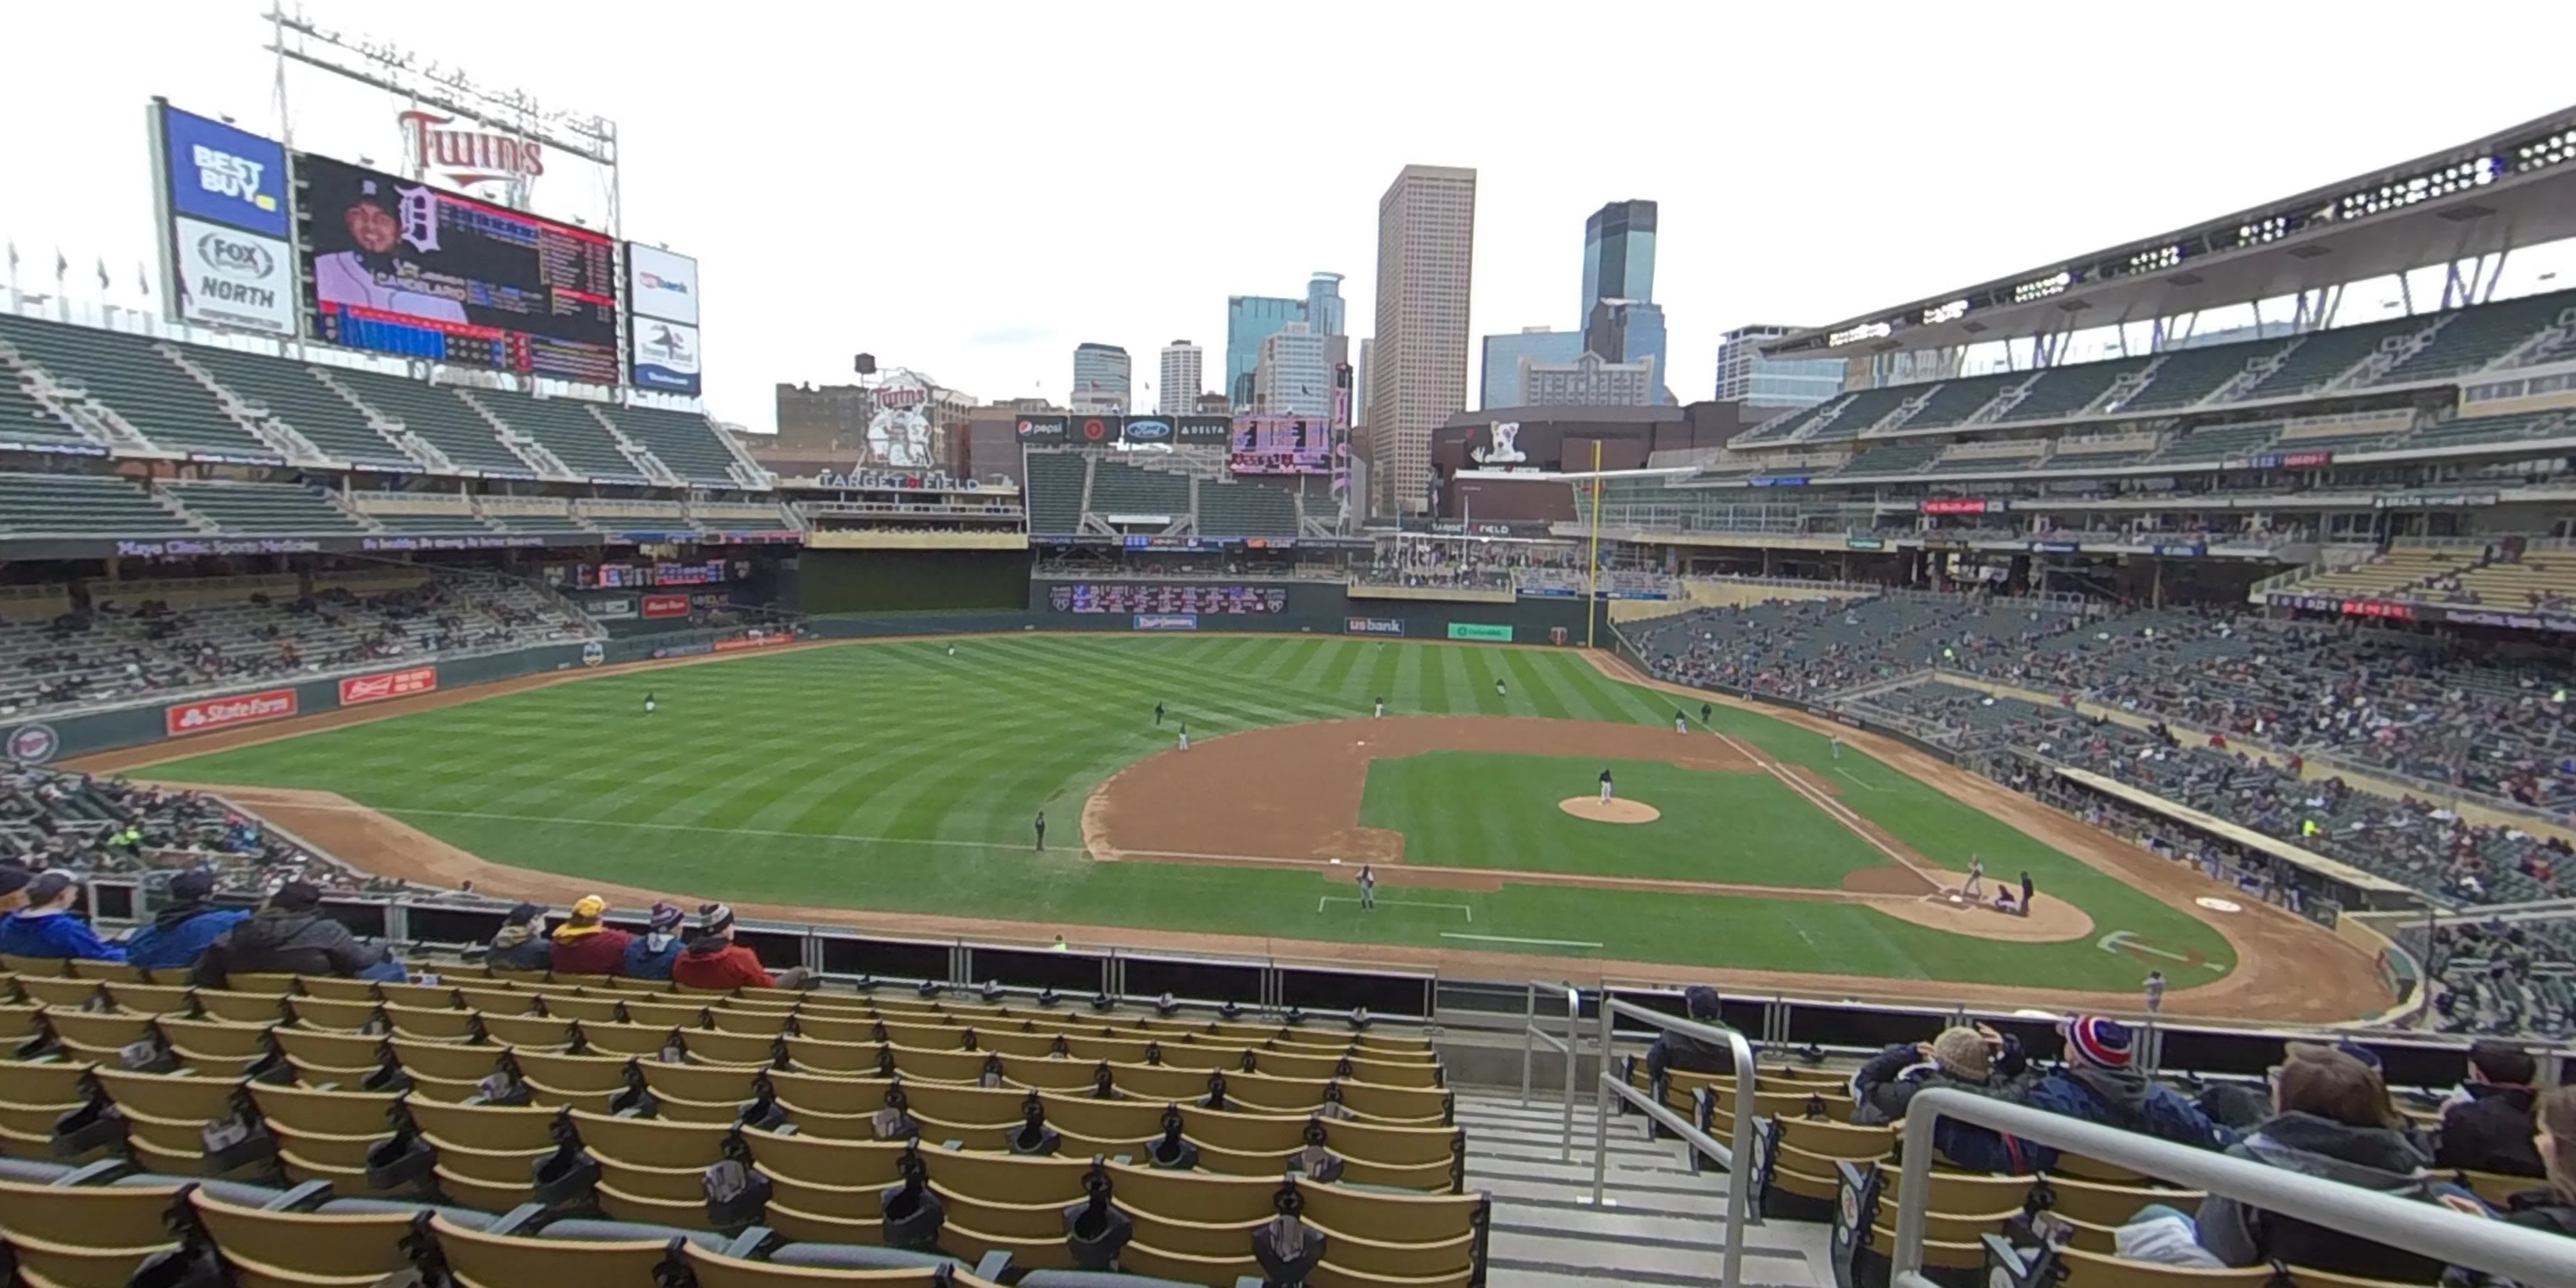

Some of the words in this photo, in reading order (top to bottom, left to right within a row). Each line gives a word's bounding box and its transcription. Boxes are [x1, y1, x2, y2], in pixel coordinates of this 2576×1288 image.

[398, 109, 543, 176] Twins
[192, 144, 264, 180] BEST
[201, 169, 259, 203] BUY
[214, 239, 258, 272] FOX
[201, 276, 275, 308] NORTH
[873, 386, 924, 407] Twins
[1033, 424, 1063, 435] pepsi
[1191, 425, 1224, 435] DELTA
[819, 474, 904, 488] TARGET
[924, 477, 980, 491] FIELD
[1479, 525, 1509, 534] FIELD
[208, 702, 249, 723] State
[250, 697, 288, 715] Farm
